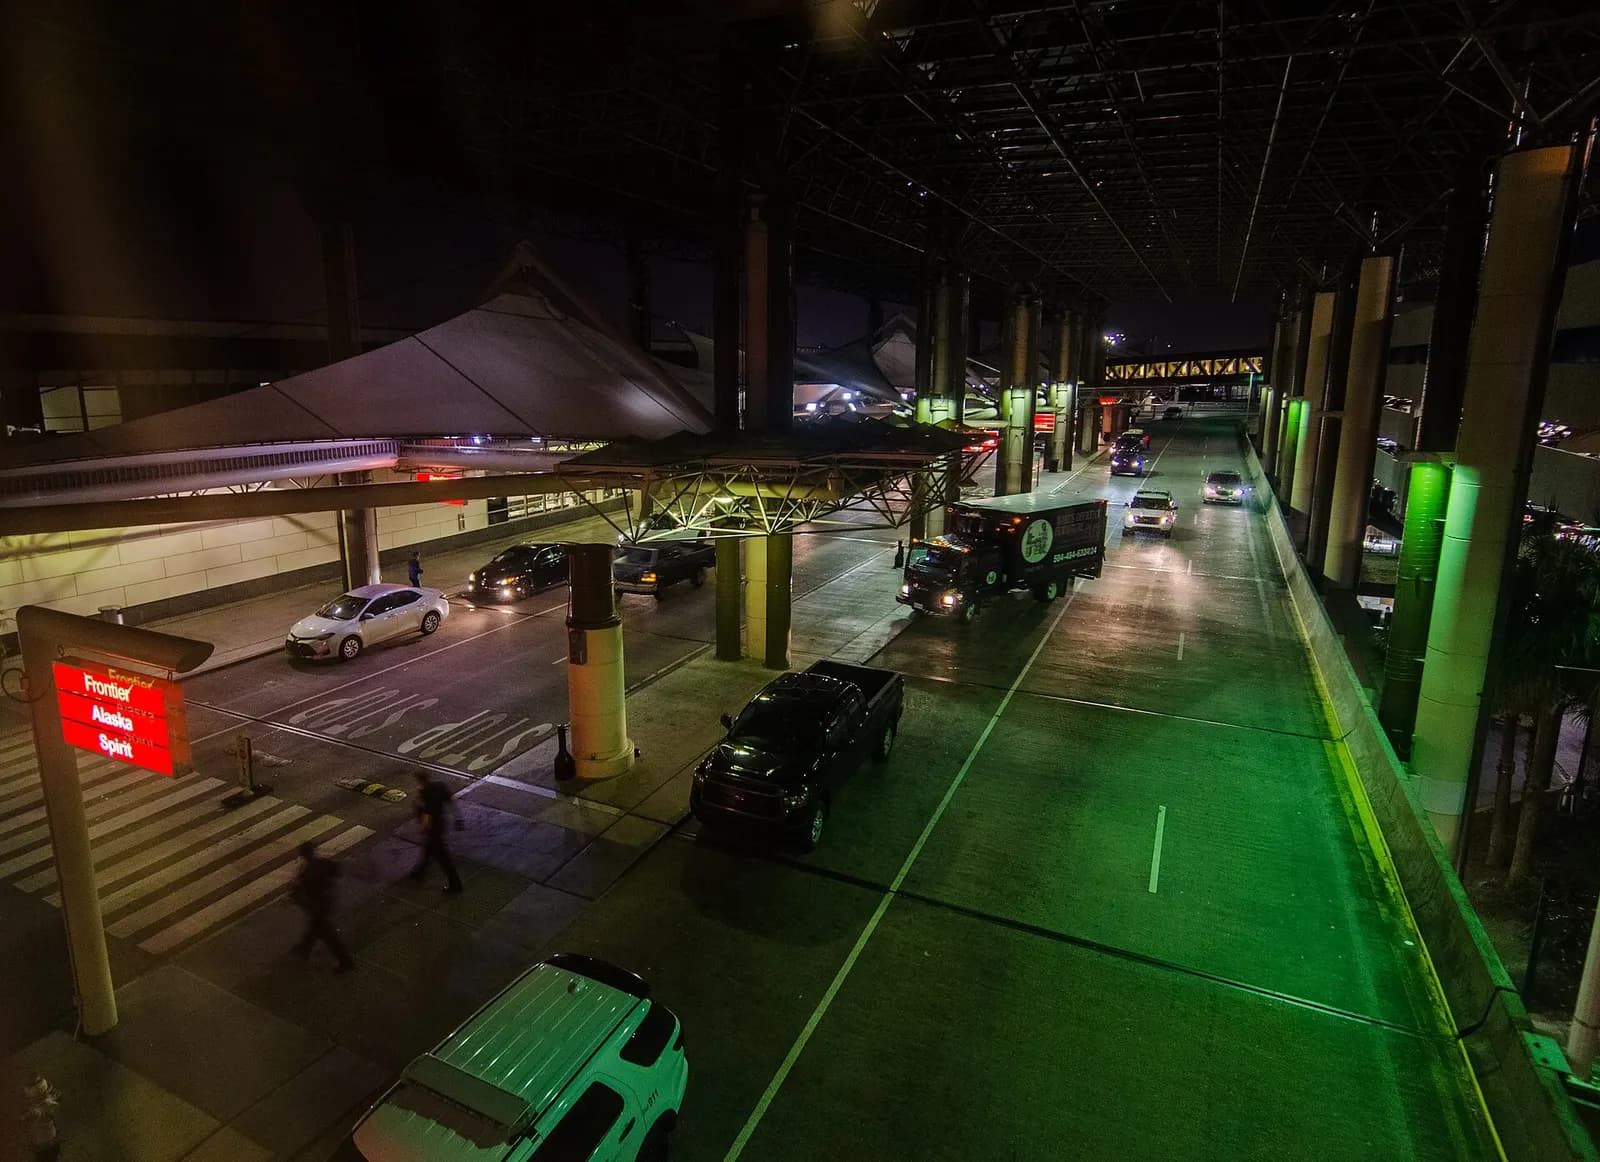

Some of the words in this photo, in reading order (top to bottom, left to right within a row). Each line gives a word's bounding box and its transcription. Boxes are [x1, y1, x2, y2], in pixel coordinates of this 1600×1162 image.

[84, 672, 133, 703] Frontier
[92, 704, 133, 732] Alaska
[99, 733, 133, 758] Spirit
[397, 709, 553, 771] STOP
